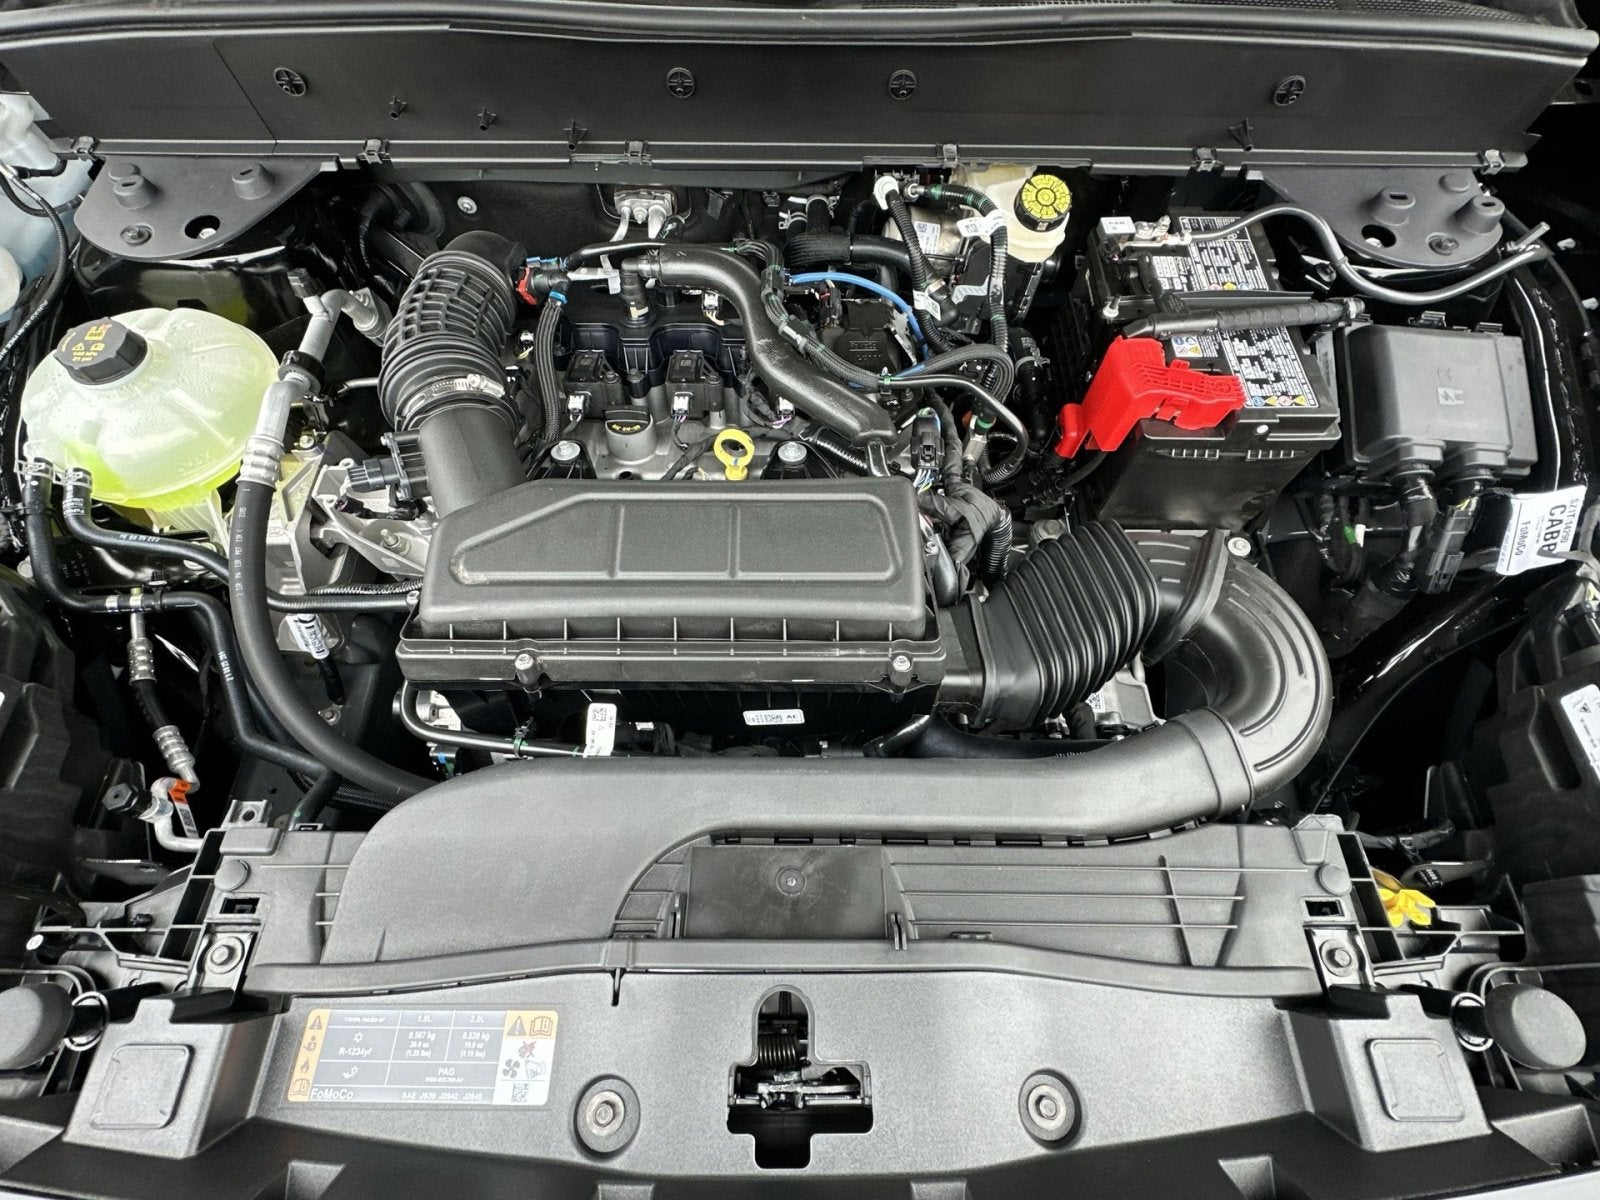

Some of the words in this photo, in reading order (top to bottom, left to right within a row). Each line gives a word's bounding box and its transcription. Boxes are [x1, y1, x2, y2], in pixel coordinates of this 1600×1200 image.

[1541, 504, 1567, 552] CABP
[338, 1047, 373, 1058] R-1234yf
[310, 1088, 354, 1100] FoMoCo
